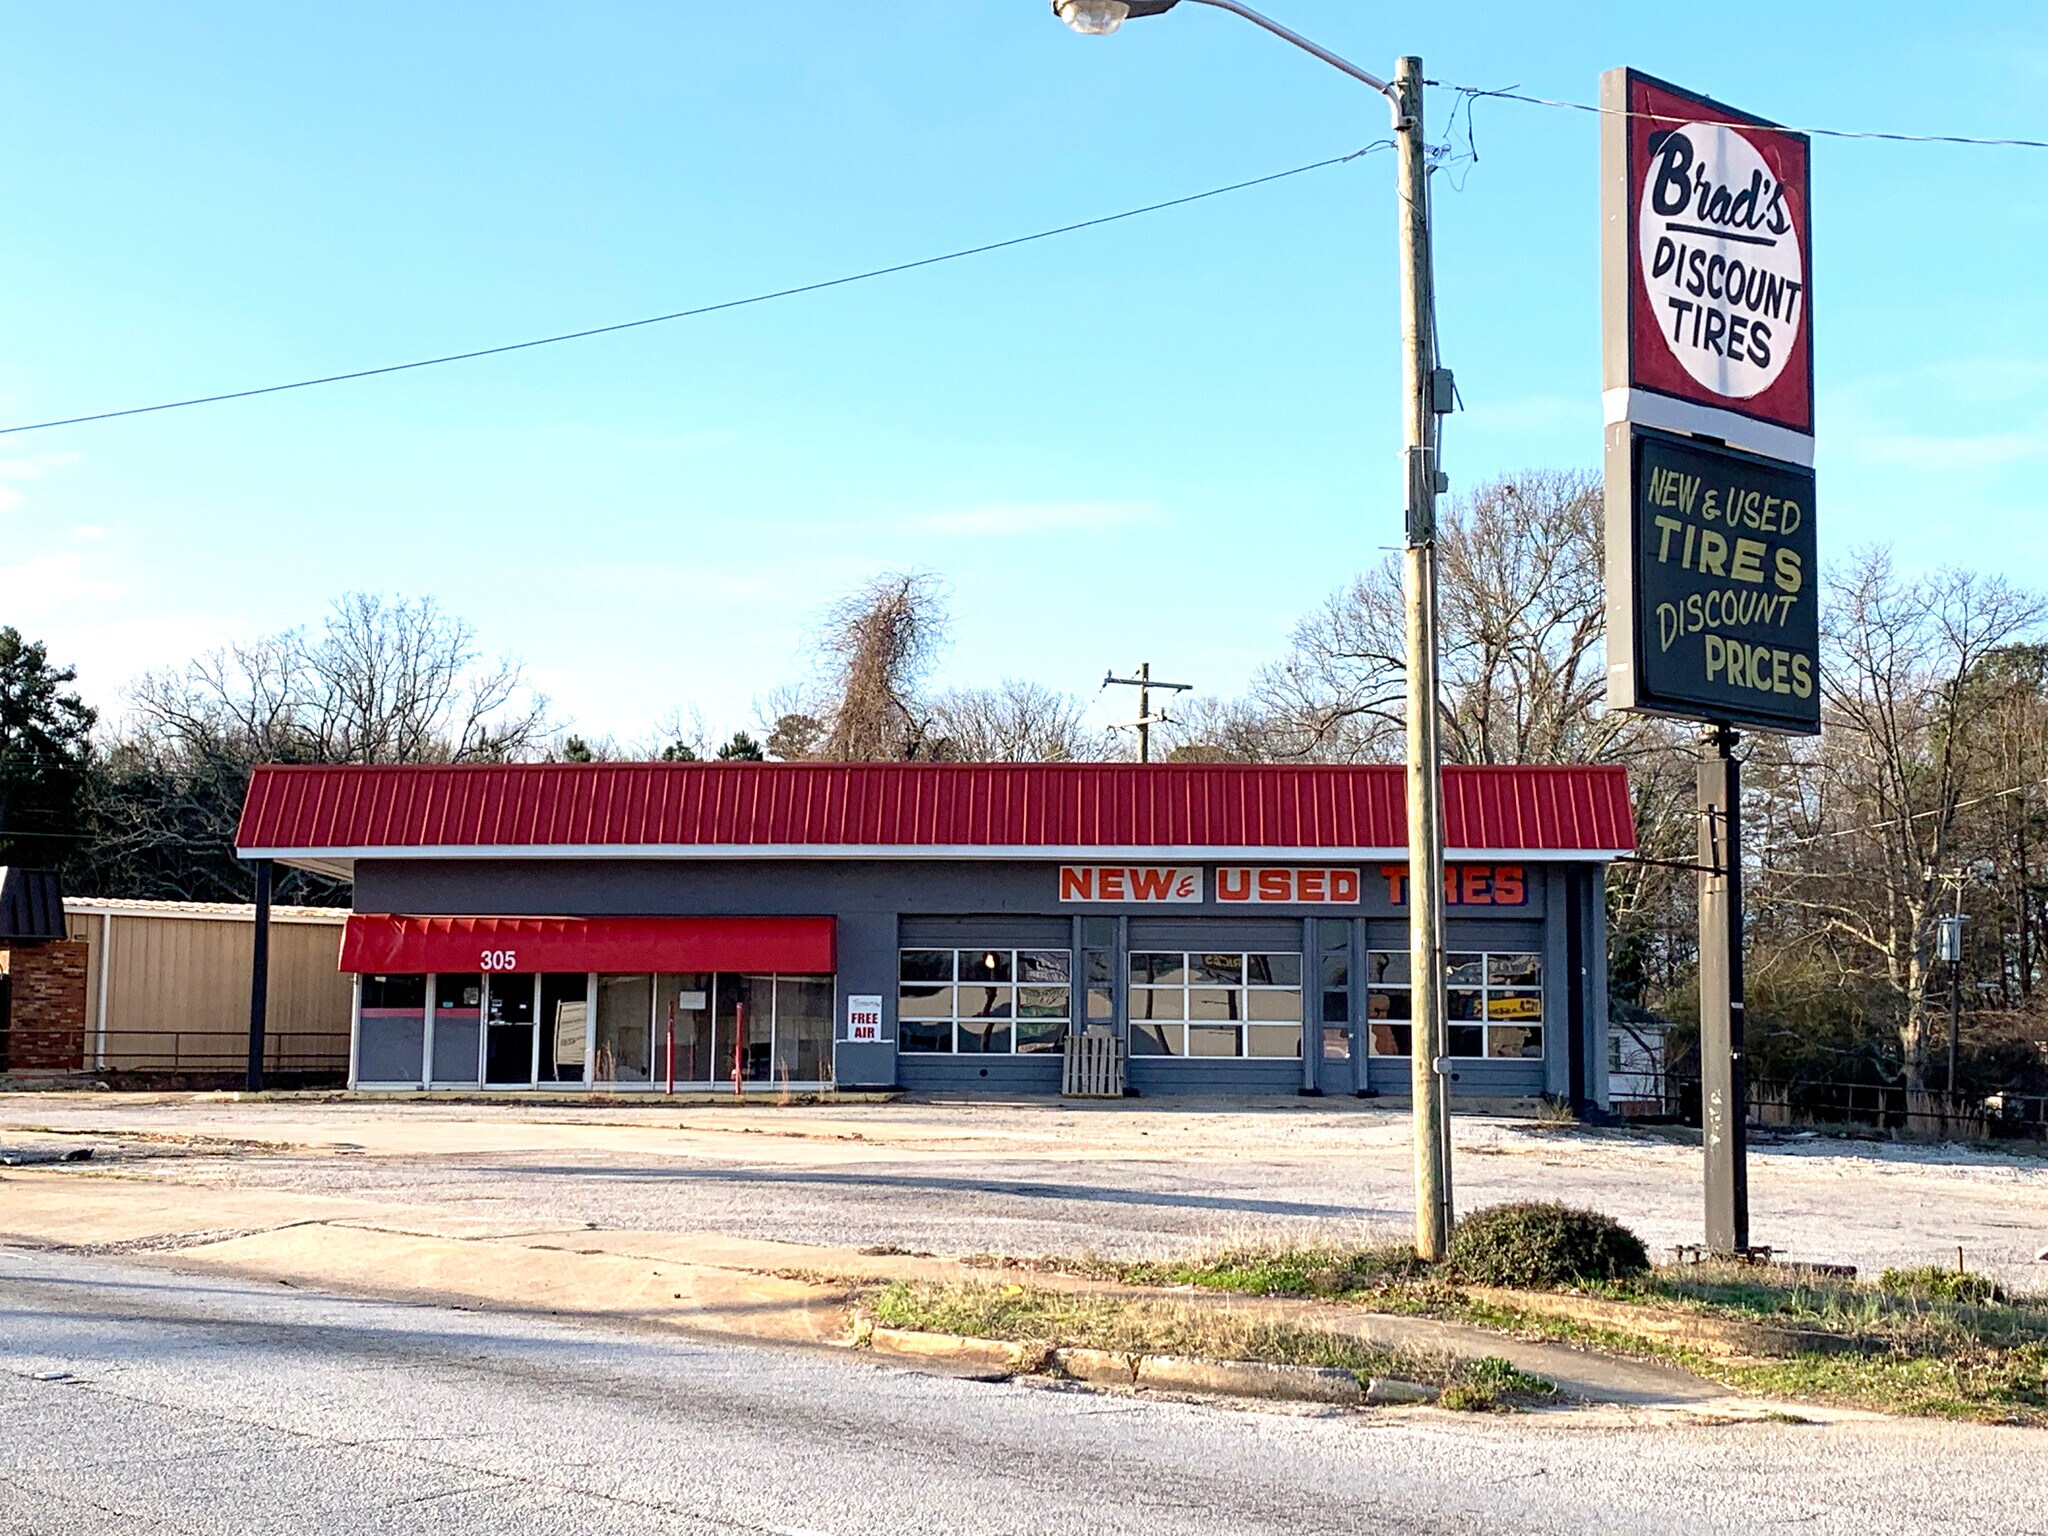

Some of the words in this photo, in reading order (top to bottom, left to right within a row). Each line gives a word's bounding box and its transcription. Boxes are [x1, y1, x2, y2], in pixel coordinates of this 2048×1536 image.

[1648, 131, 1791, 235] Brad's
[1652, 236, 1802, 325] DISCOUNT
[1668, 296, 1772, 369] TIRES
[1648, 466, 1701, 516] NEW
[1702, 489, 1722, 521] &
[1726, 487, 1801, 536] USED
[1654, 515, 1802, 593] TIRES
[1656, 589, 1798, 652] DISCOUNT
[1704, 634, 1813, 699] PRICES
[1218, 869, 1358, 902] USED
[1379, 864, 1528, 906] TES
[480, 950, 517, 970] 305
[851, 1012, 879, 1024] FREE
[854, 1027, 875, 1038] AIR
